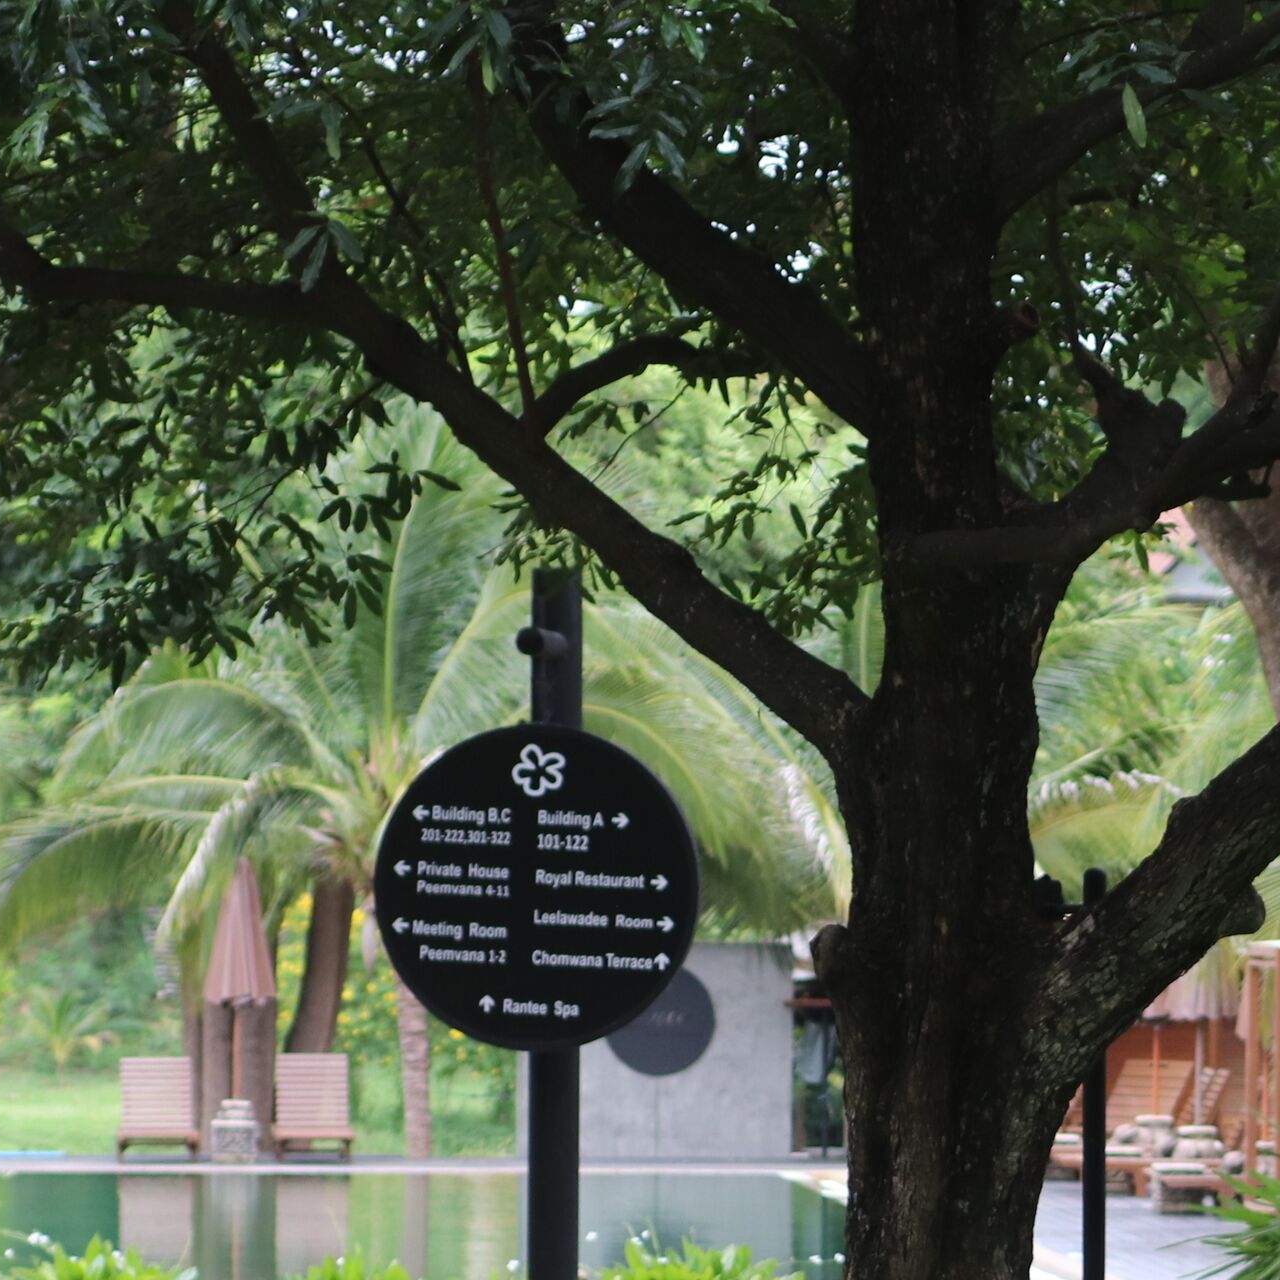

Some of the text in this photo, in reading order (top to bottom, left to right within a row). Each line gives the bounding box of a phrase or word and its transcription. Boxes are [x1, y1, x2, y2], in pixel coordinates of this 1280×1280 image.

[432, 805, 485, 825] Building
[538, 810, 604, 830] Building A
[538, 834, 588, 851] 101-122
[417, 861, 509, 879] Private House
[536, 869, 644, 888] Royal Restaurant
[417, 880, 509, 897] Peemvana 4-11
[534, 909, 653, 928] Leelawadee Room
[412, 920, 507, 940] Meeting Room
[420, 945, 506, 963] Peemvana 1-2
[532, 950, 653, 970] Chomwana Terrace
[503, 998, 579, 1018] Rantee Spa
